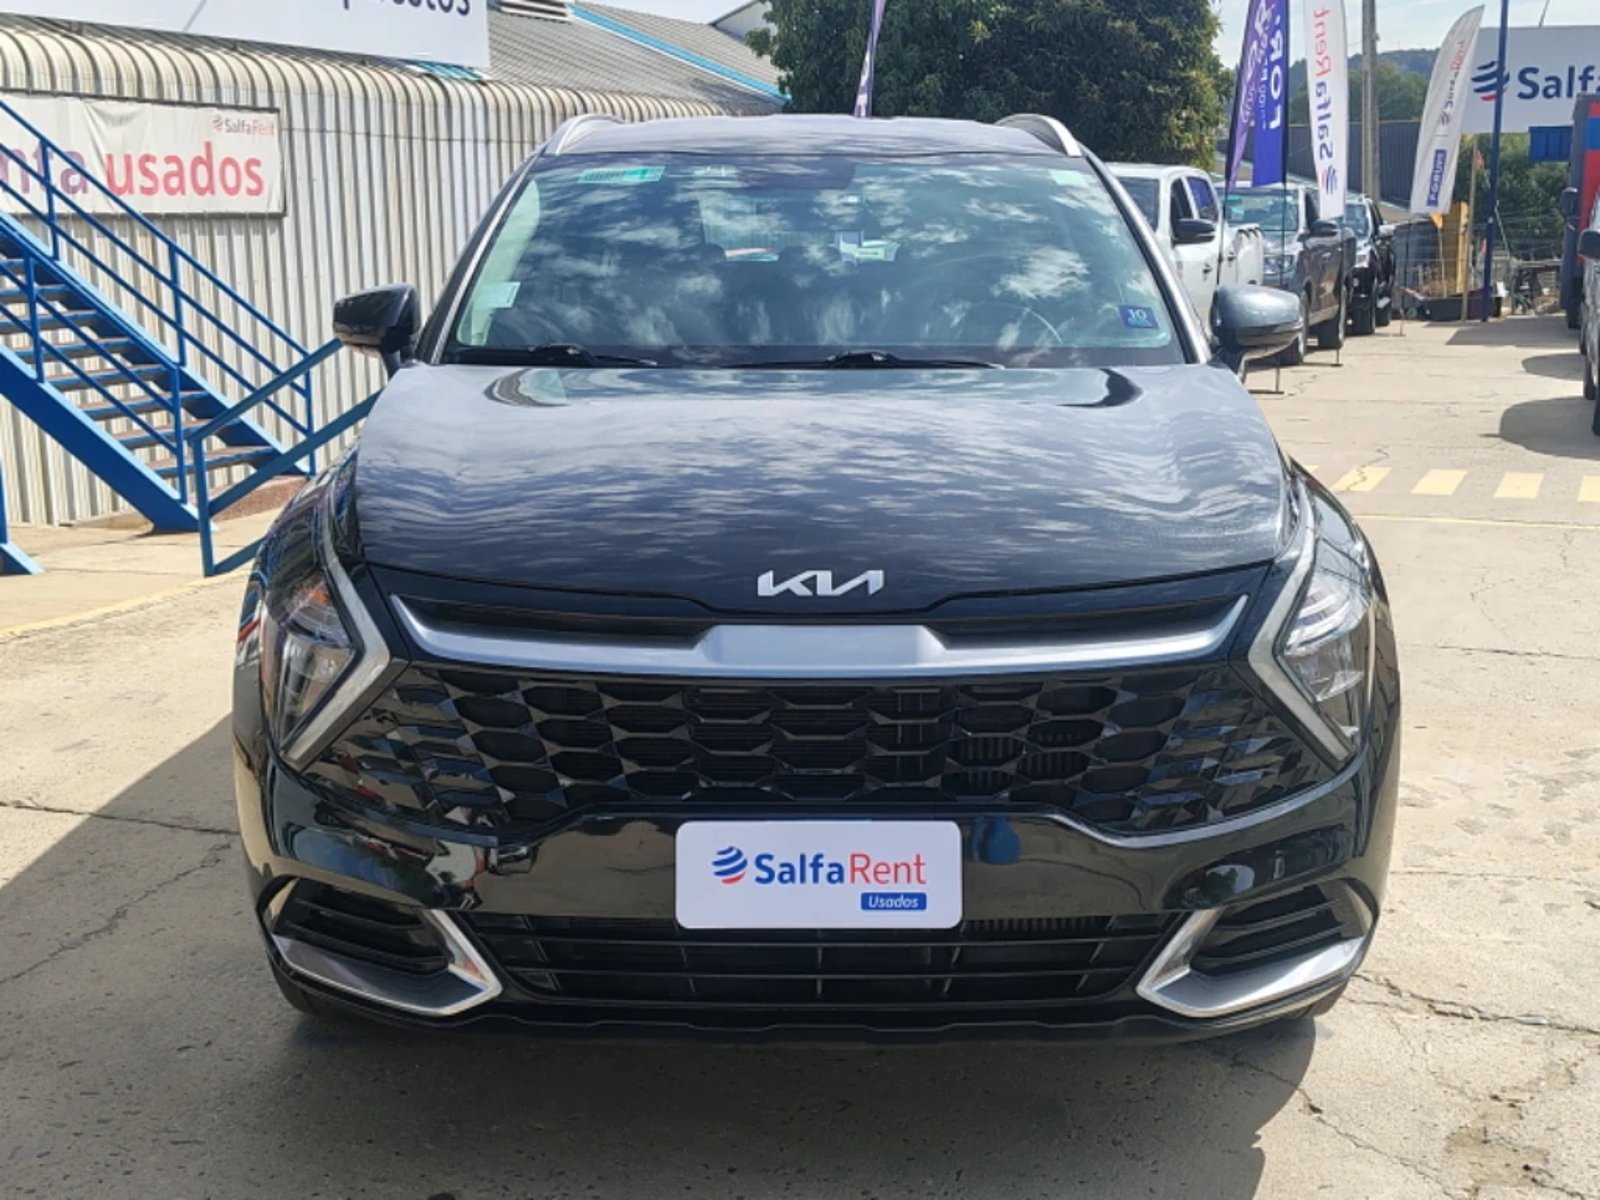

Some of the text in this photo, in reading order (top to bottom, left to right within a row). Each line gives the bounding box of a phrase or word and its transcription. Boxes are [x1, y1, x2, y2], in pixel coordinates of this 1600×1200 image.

[105, 141, 264, 197] usados
[757, 569, 884, 597] KIA
[867, 894, 919, 910] Usados
